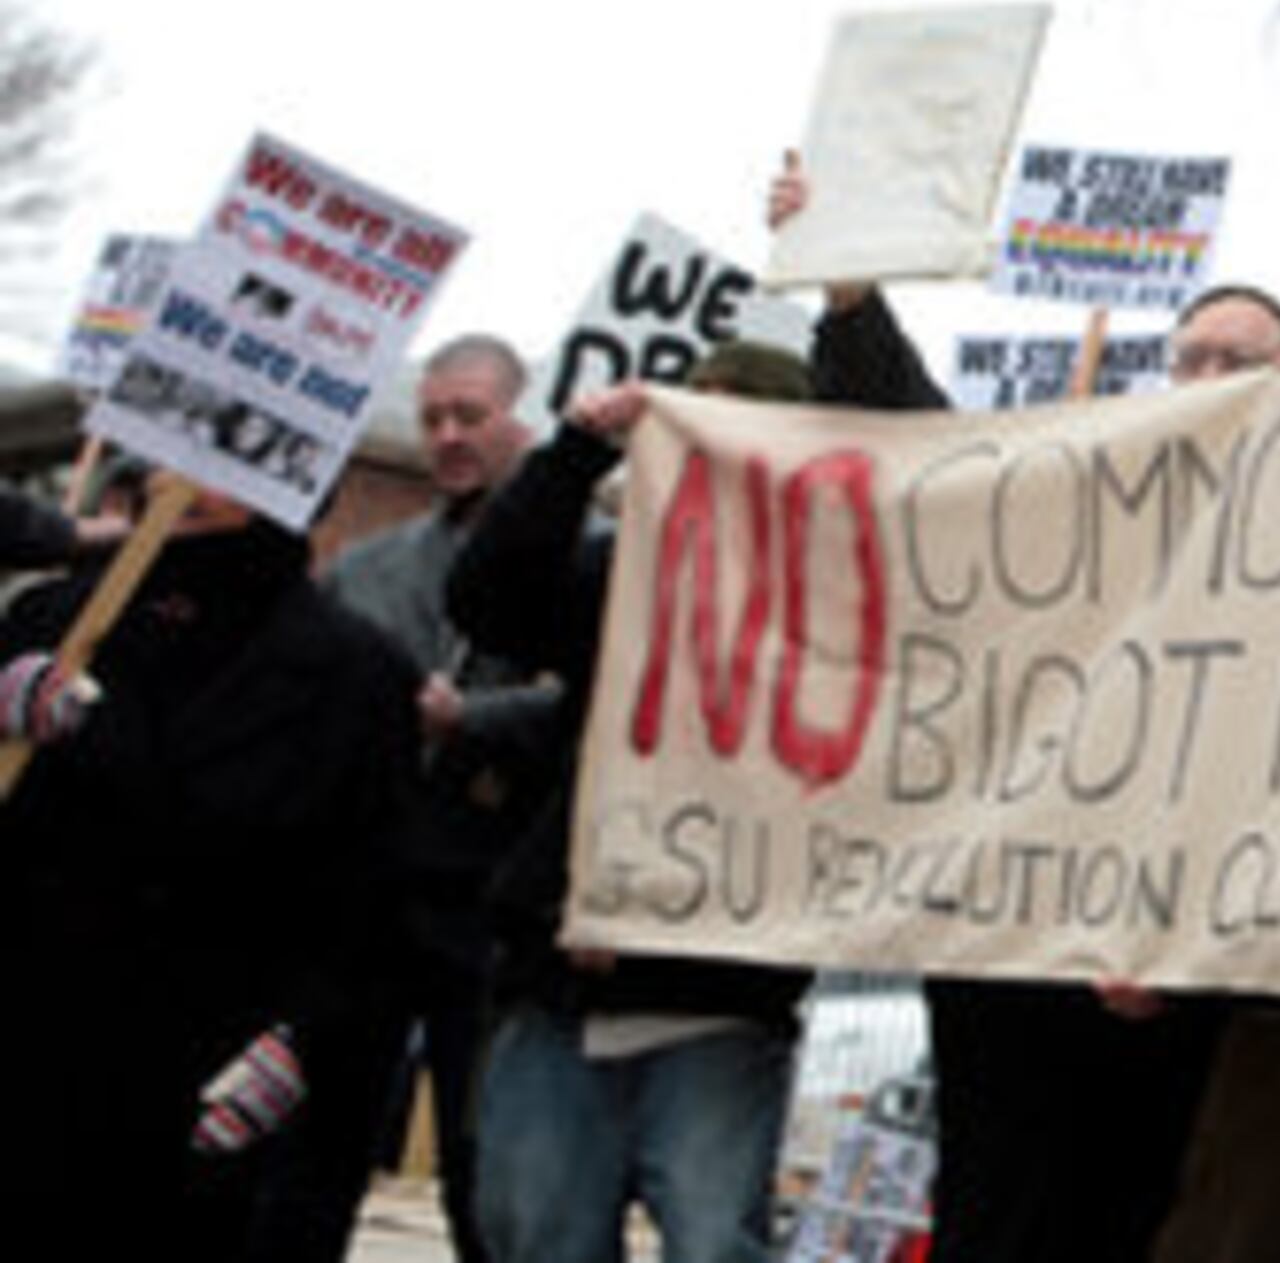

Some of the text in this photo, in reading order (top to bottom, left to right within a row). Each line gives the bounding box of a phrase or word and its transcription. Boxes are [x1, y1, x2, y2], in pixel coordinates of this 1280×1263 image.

[245, 147, 317, 212] We
[315, 191, 393, 246] are
[1021, 147, 1072, 185] WE
[160, 288, 228, 350] We
[229, 332, 298, 386] are
[611, 240, 755, 342] WE
[630, 446, 886, 791] NO
[886, 632, 1245, 804] BIGOT
